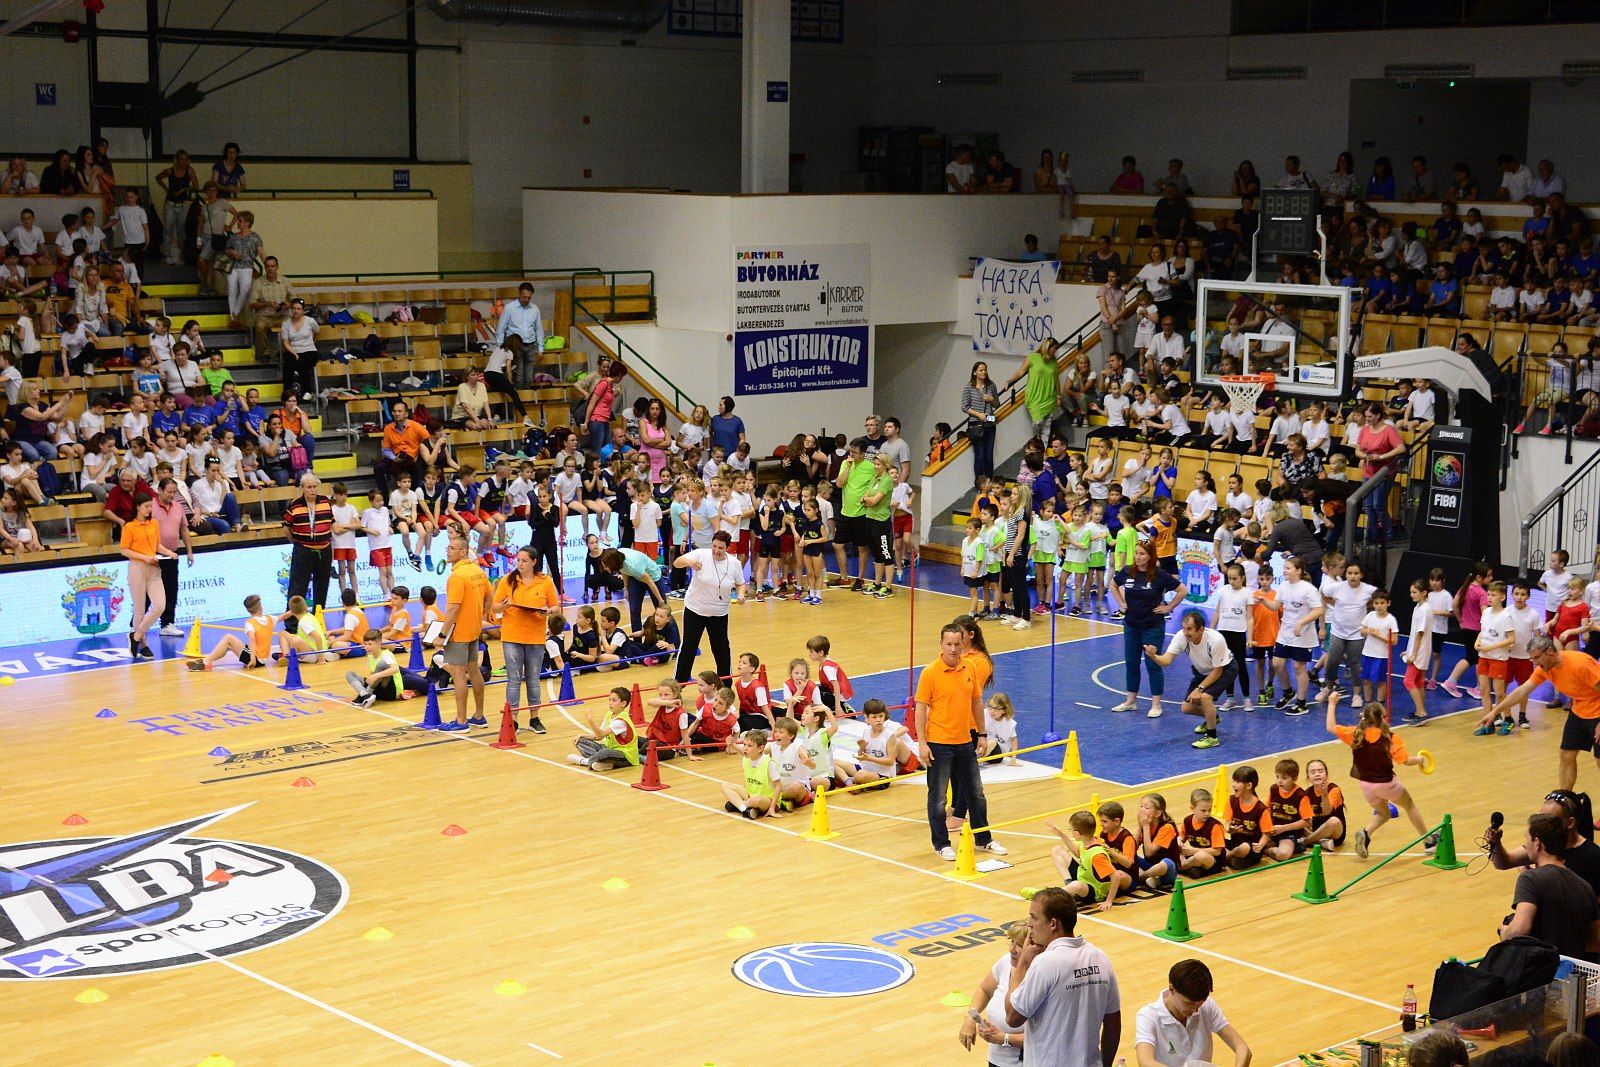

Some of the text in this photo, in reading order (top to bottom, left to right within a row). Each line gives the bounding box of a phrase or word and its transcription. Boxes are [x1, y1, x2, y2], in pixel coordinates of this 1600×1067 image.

[38, 84, 56, 96] WC
[737, 251, 784, 260] PARTNER
[737, 260, 820, 283] BÚTORHÁZ
[981, 263, 1044, 295] HAJRÁ
[737, 289, 781, 299] IRODABÚTOROK
[829, 286, 865, 303] KARRIER
[785, 302, 811, 313] GYÁRTÁS
[841, 305, 864, 313] BÚTOR
[736, 319, 785, 330] LAKBERENDEZÉS
[974, 308, 1053, 342] TÓVÁROS
[743, 333, 861, 372] KONSTRUKTOR
[772, 364, 834, 379] Építőipari Kft.
[801, 378, 860, 388] www.konstruktor.hu
[1438, 430, 1464, 440] SPALDING
[1434, 493, 1457, 508] FIBA
[880, 534, 892, 560] adidas
[75, 902, 304, 956] sportopus
[871, 913, 992, 948] FIBA
[908, 920, 1018, 958] EUR
